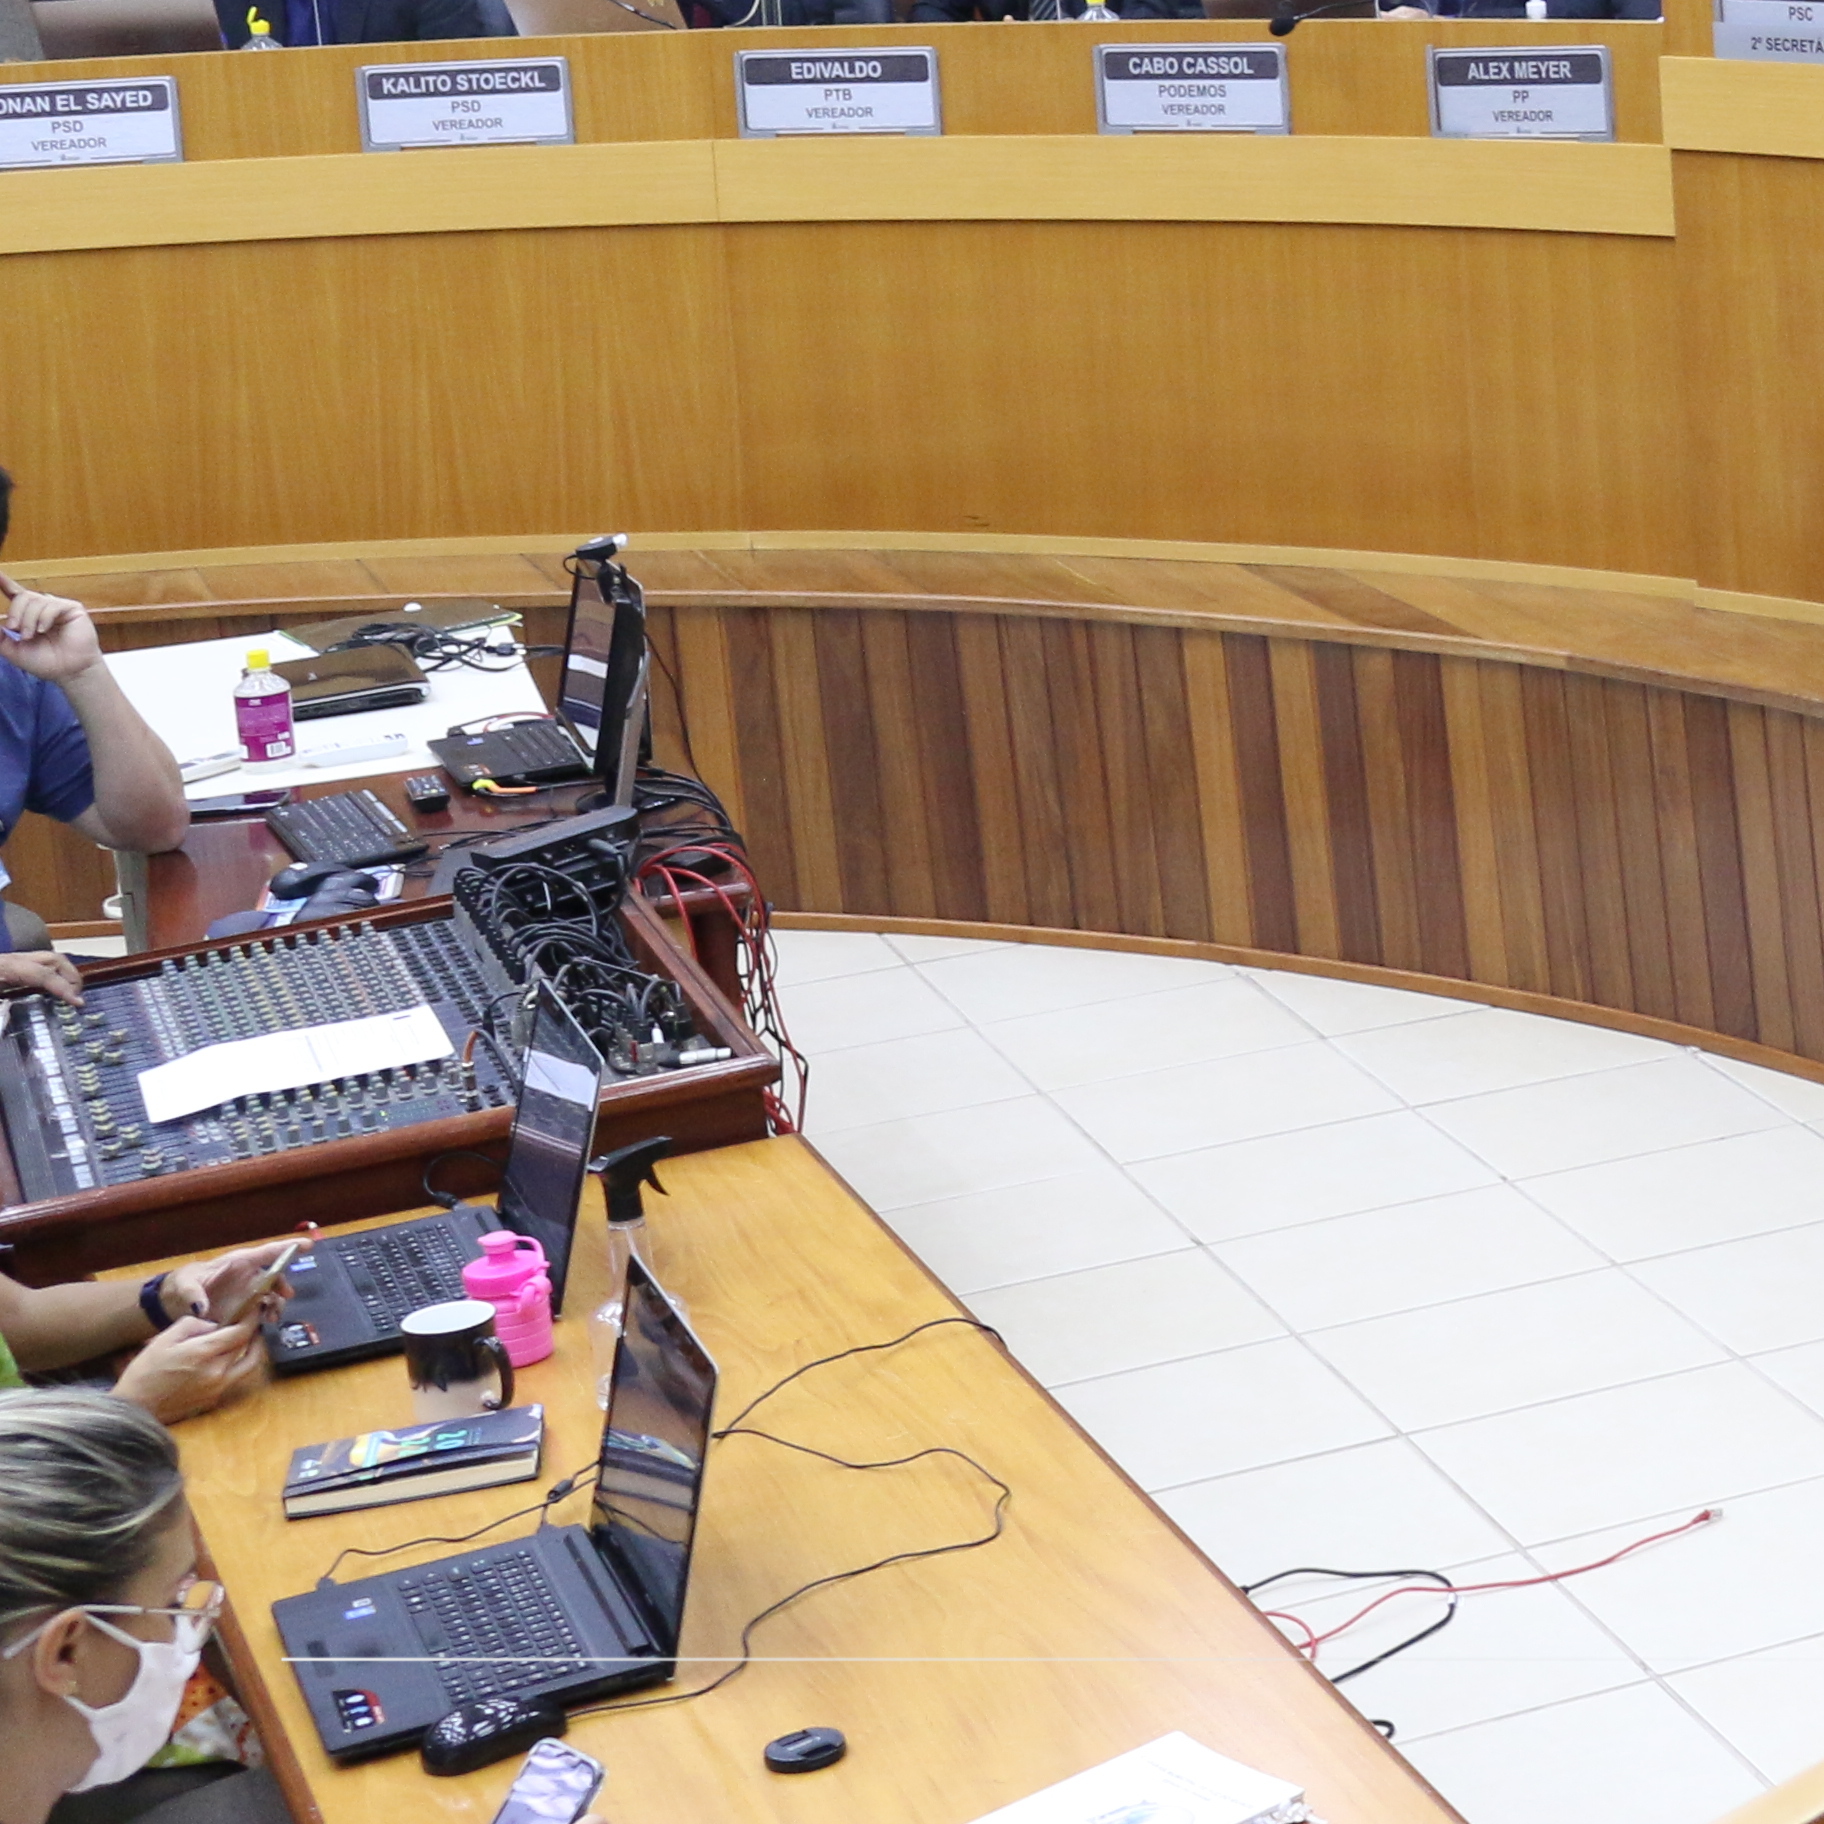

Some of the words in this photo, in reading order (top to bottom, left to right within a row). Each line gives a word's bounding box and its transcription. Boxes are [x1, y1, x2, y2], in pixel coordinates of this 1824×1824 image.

[1788, 6, 1814, 22] PSC
[790, 61, 882, 80] EDIVALDO
[1128, 57, 1178, 74] CABO
[1183, 56, 1254, 74] CASSOL
[1467, 62, 1511, 80] ALEX
[1514, 61, 1572, 79] MEYER
[381, 76, 451, 94] KALITO
[456, 71, 546, 90] STOECKL
[824, 88, 853, 101] PTB
[1158, 84, 1226, 98] PODEMOS
[1512, 89, 1530, 103] PP
[55, 94, 82, 111] EL
[86, 90, 152, 109] SAYED
[451, 99, 481, 113] PSD
[805, 106, 874, 119] VEREADOR
[1161, 104, 1226, 115] VEREADOR
[1492, 110, 1554, 122] VEREADOR
[51, 120, 84, 133] PSD
[432, 118, 503, 131] VEREADOR
[31, 137, 107, 151] VEREADOR
